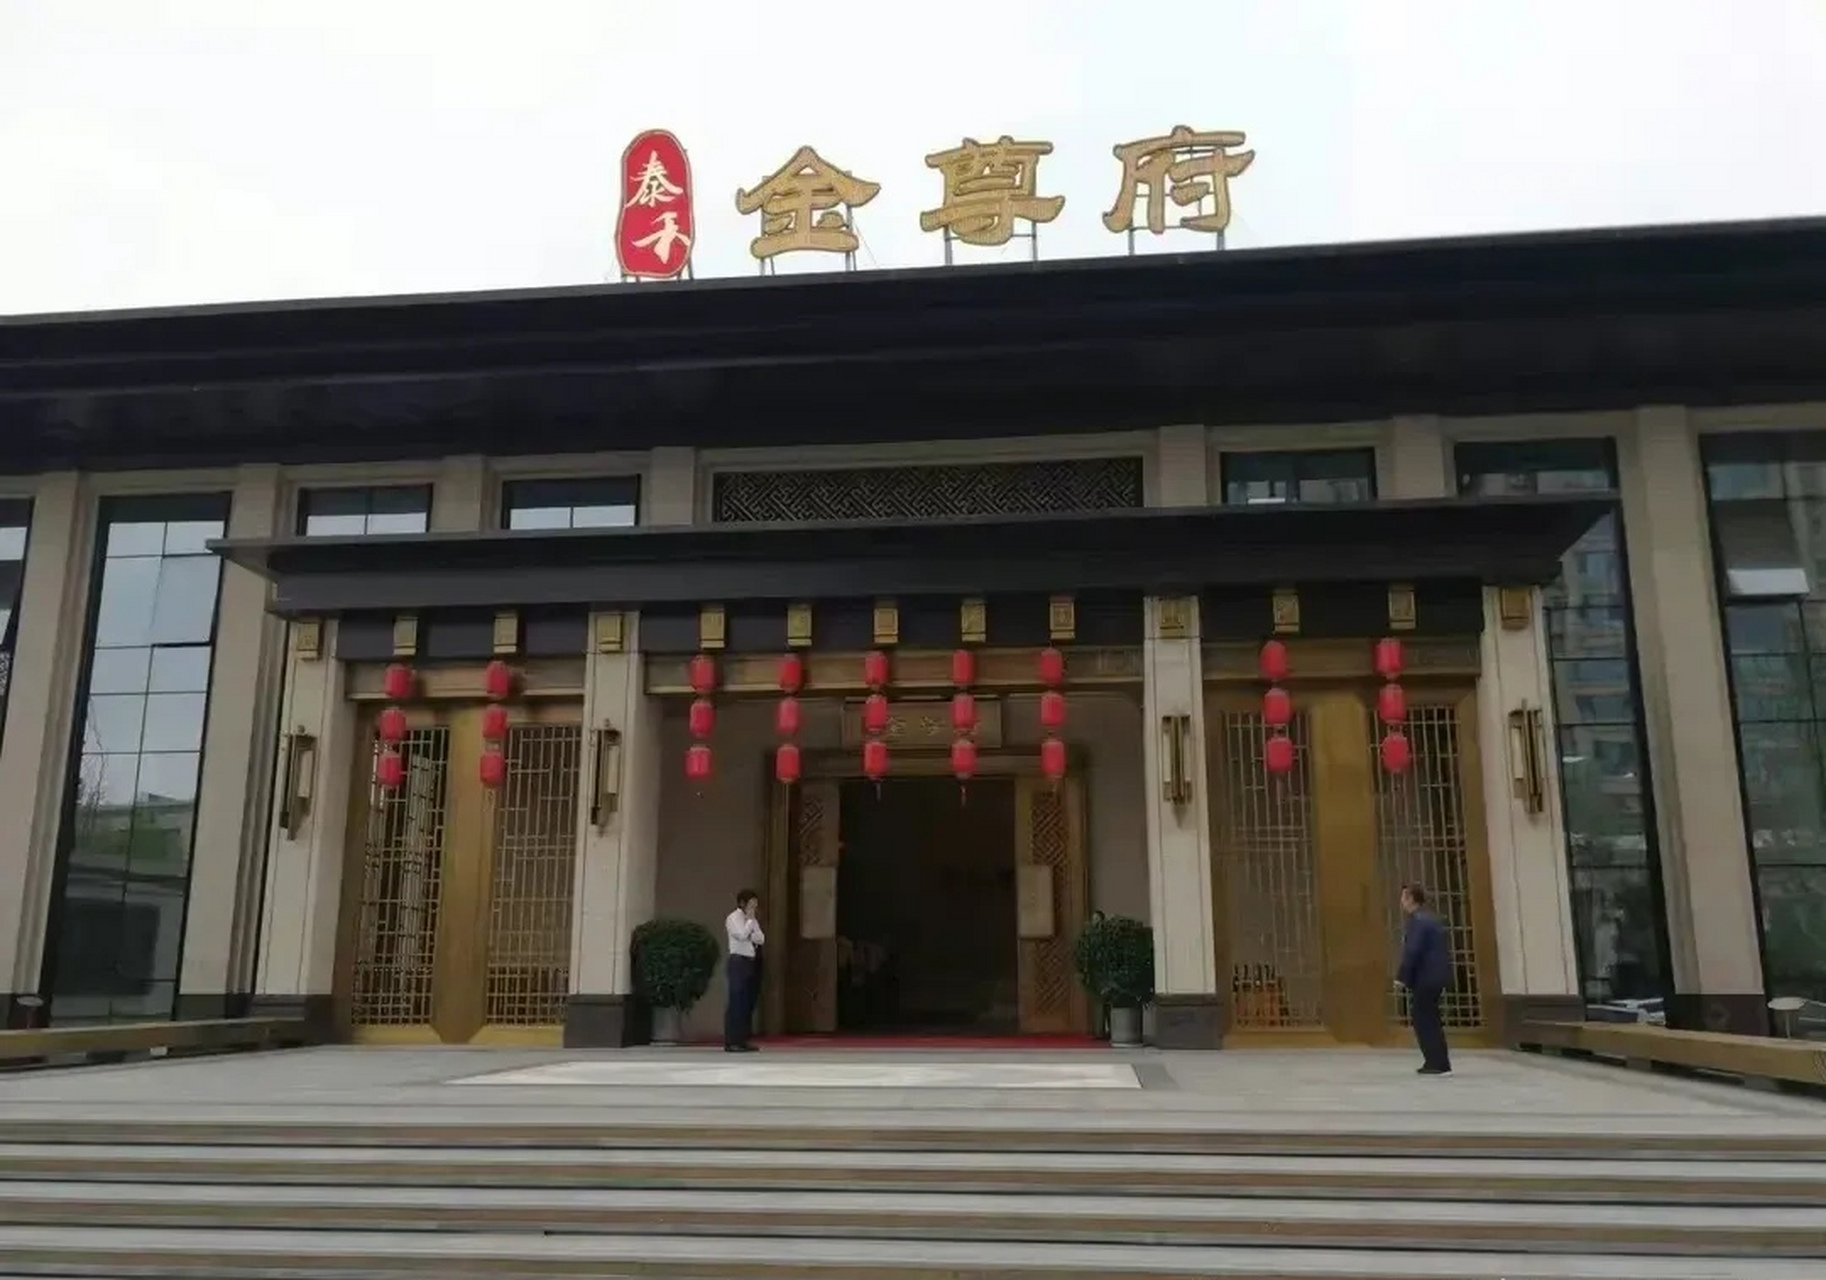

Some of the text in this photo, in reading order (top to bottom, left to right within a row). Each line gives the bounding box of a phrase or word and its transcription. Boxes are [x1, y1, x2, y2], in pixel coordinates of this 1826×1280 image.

[624, 149, 691, 265] 泰禾
[735, 125, 1255, 260] 金尊府
